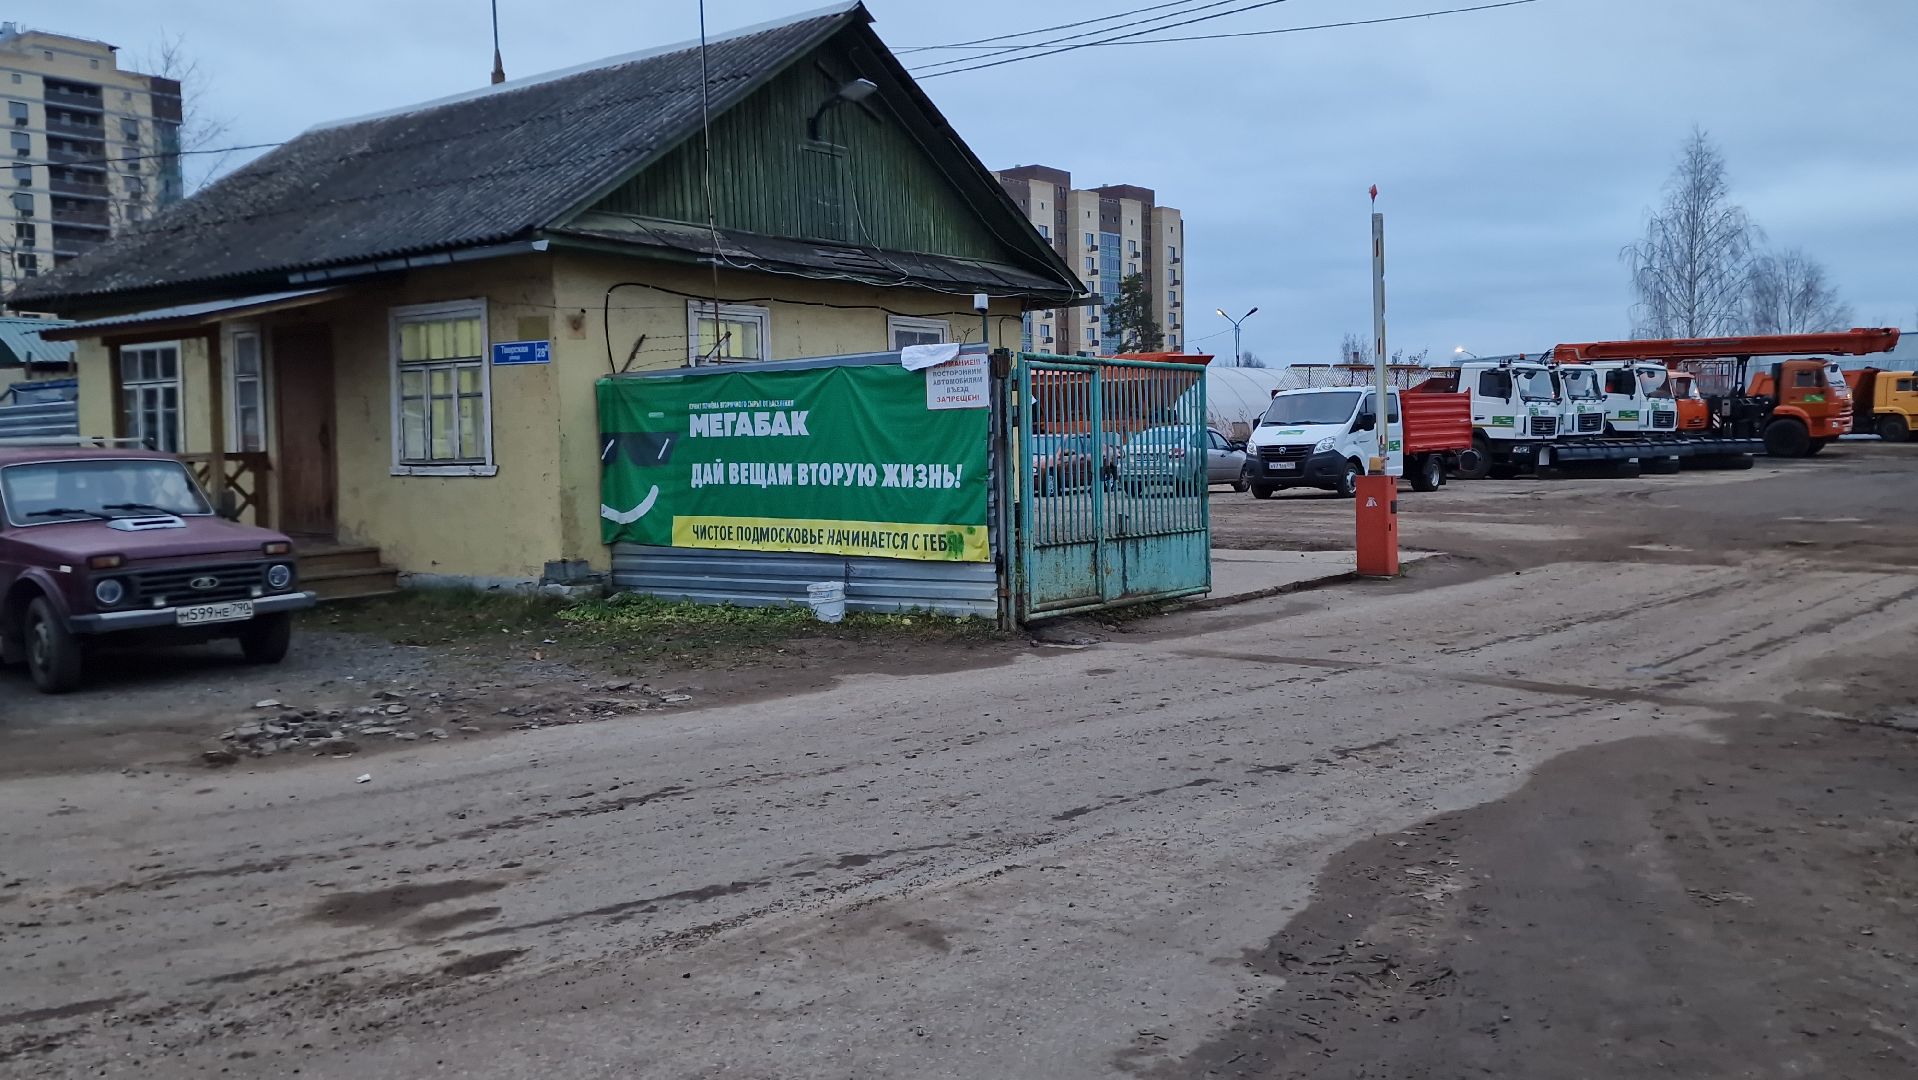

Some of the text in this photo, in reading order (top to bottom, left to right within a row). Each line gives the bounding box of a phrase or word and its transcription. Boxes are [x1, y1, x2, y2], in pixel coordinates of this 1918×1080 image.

[932, 368, 982, 377] ПОСТОРОННИМ
[932, 377, 983, 386] АВТОМОБИЛЯМ
[946, 386, 969, 394] ВЪЕЗД
[689, 410, 810, 438] МЕГАБАК
[690, 458, 963, 489] ДАЙ ВЕЩАМ ВТОРУЮ ЖИЗНЬ!
[692, 524, 733, 541] ЧИСТОЕ
[736, 526, 824, 545] ПОДМОСКОВЬЕ
[827, 528, 909, 551] НАЧИНАЕТСЯ
[912, 533, 920, 550] С
